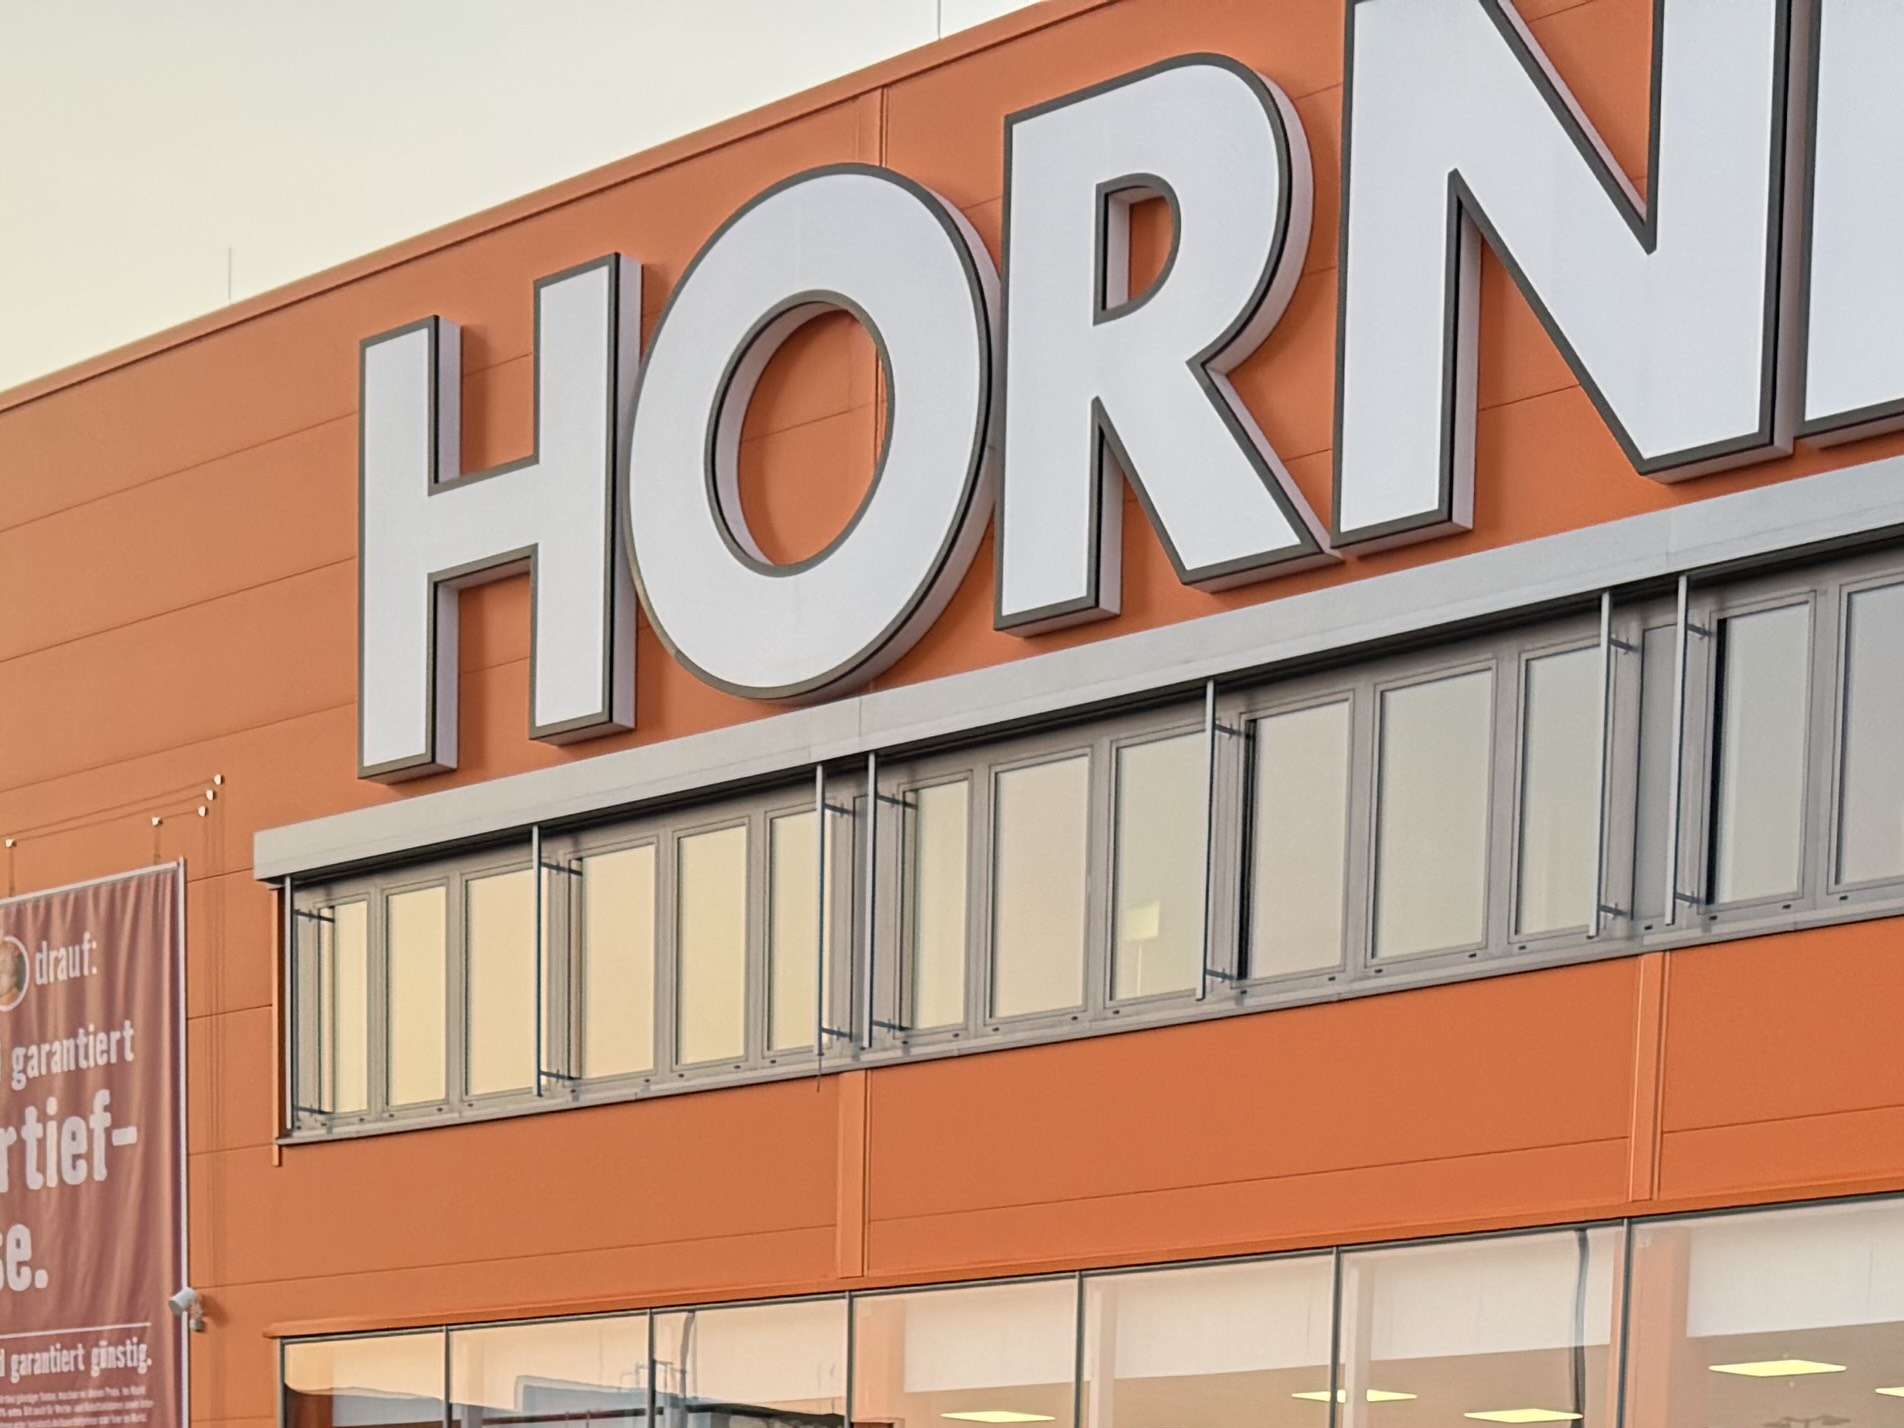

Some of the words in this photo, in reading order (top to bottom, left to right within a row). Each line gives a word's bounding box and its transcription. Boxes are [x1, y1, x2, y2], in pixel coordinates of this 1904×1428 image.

[34, 931, 98, 985] drauf:
[10, 1020, 135, 1091] garantiert
[10, 1343, 86, 1384] garantiert
[90, 1336, 153, 1377] günstig.
